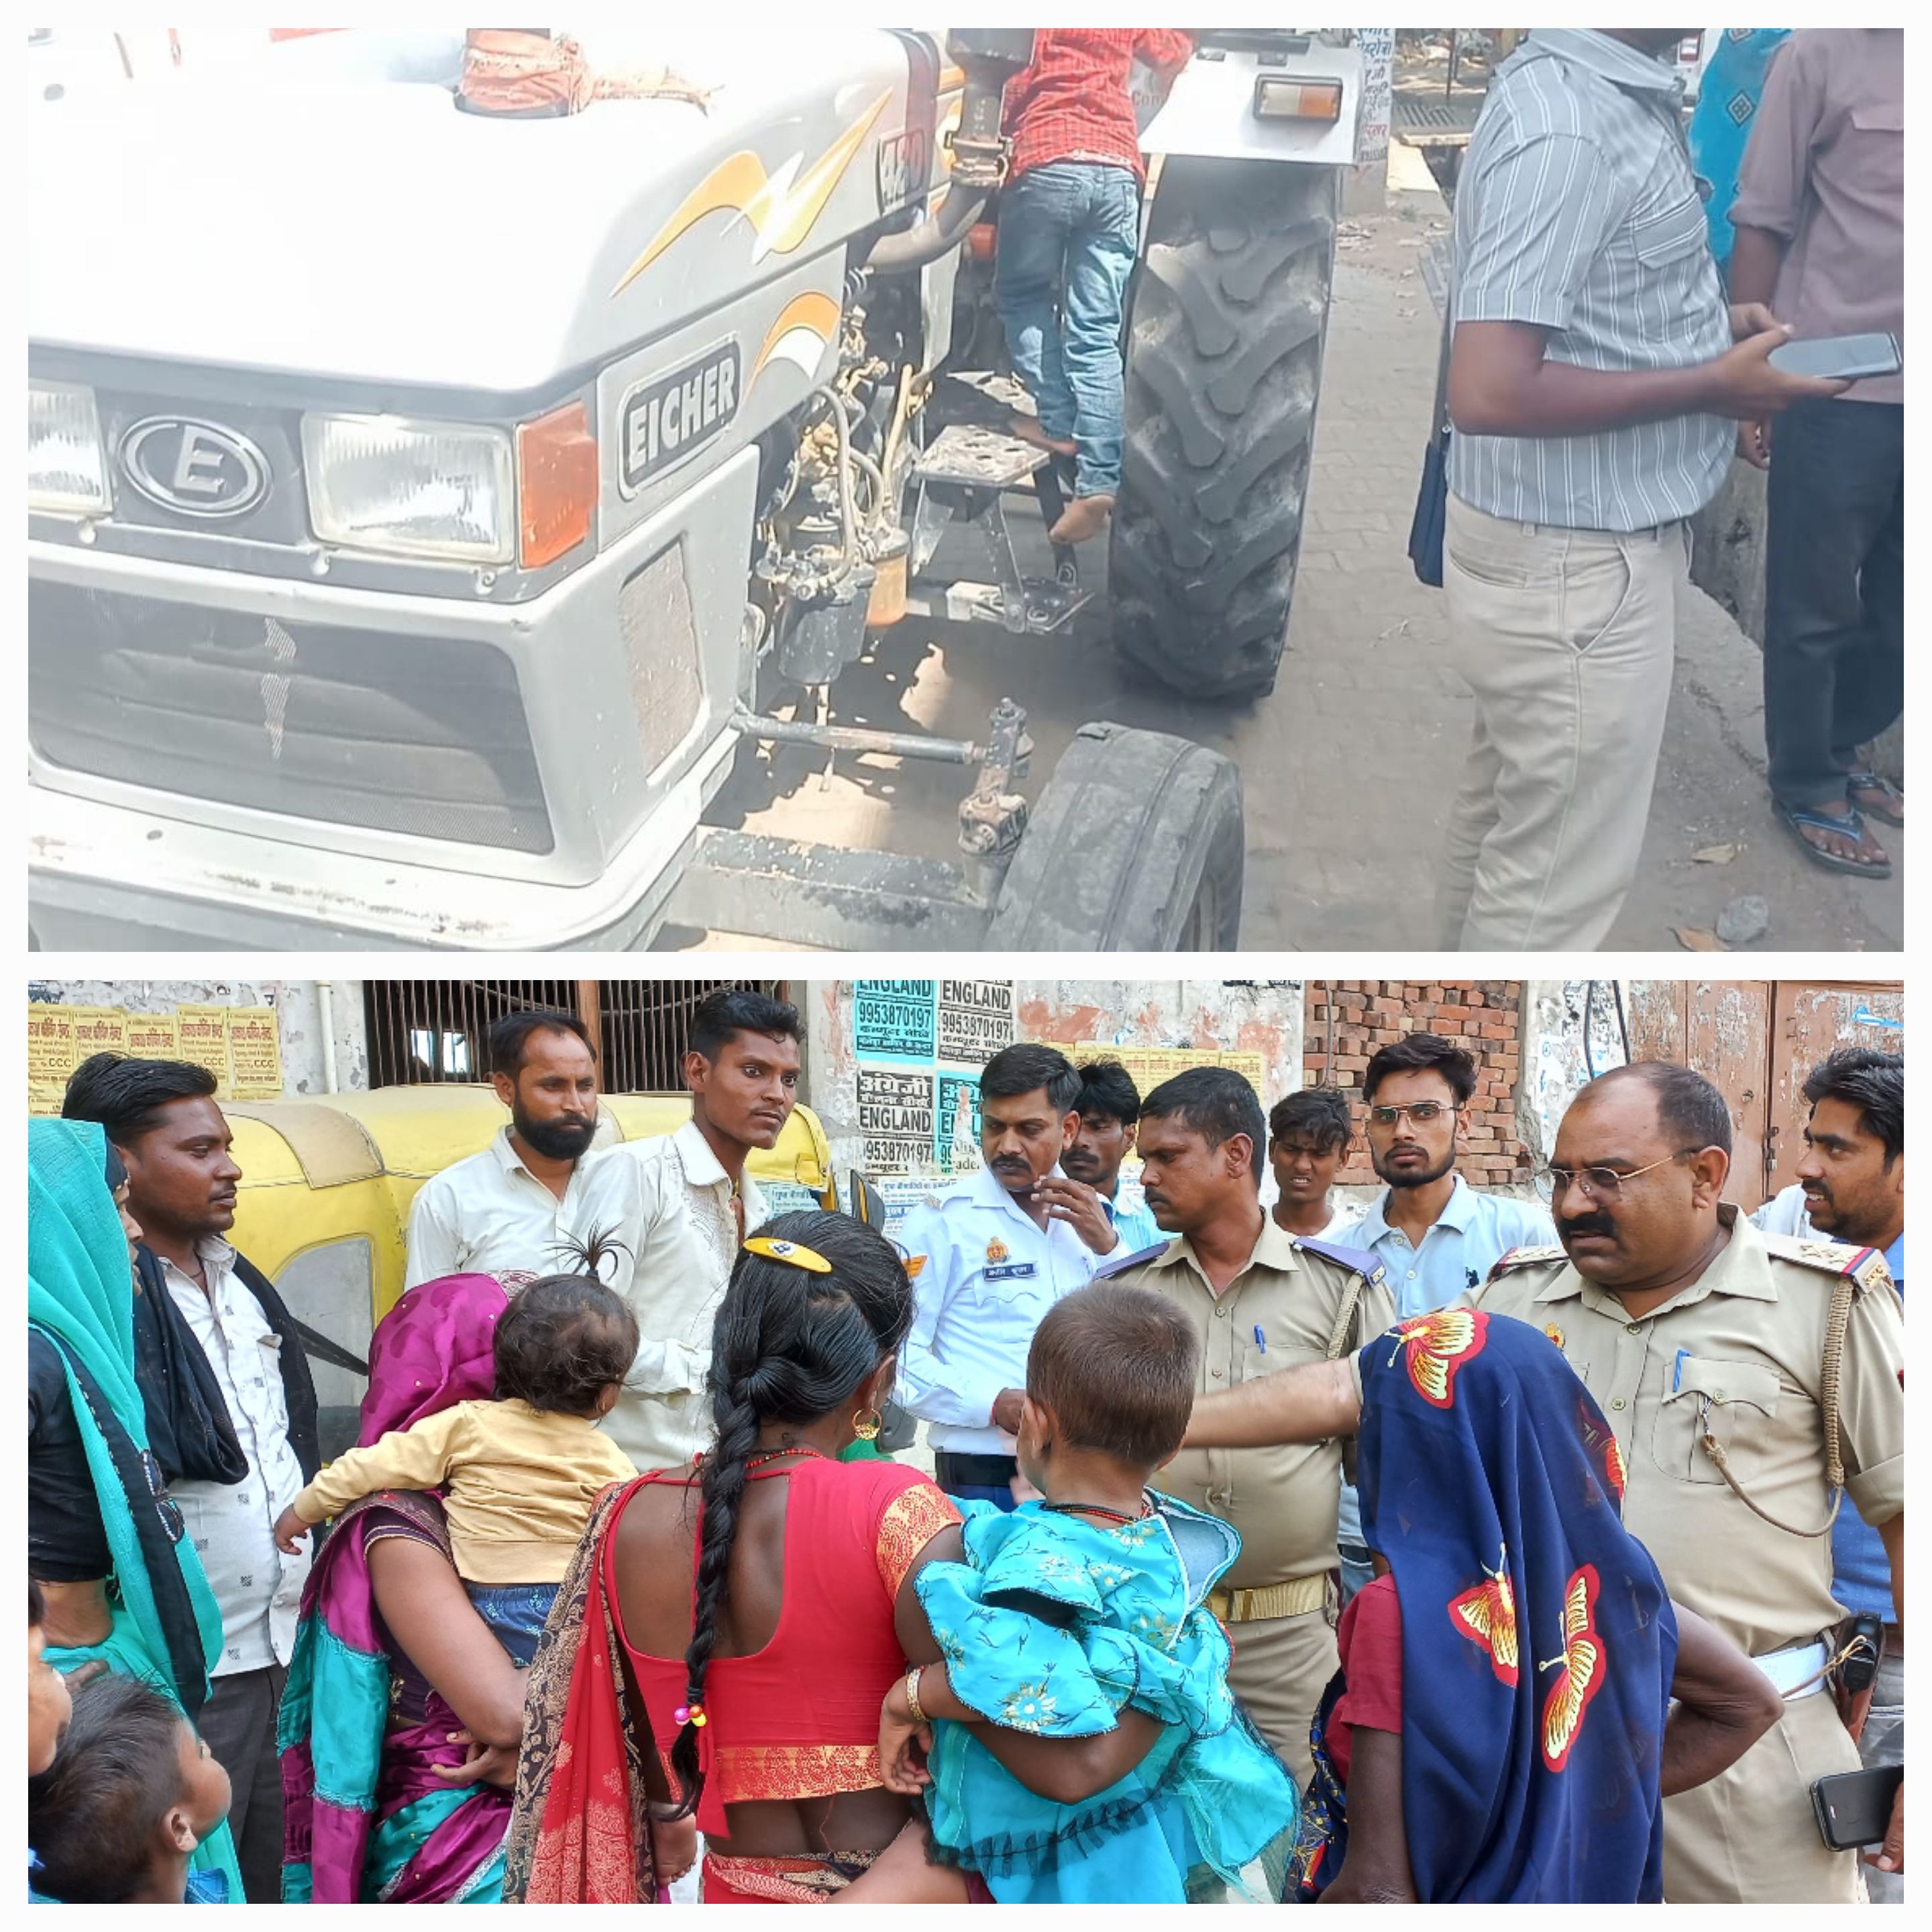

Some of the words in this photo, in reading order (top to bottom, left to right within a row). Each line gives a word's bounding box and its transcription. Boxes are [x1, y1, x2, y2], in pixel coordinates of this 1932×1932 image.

[629, 357, 735, 474] EICHER
[859, 980, 931, 997] ENGLAND
[942, 980, 1011, 1010] ENGLAND
[859, 1001, 931, 1028] 9953870197
[942, 1012, 1010, 1040] 9953870197
[48, 1057, 72, 1067] CCC
[254, 1059, 275, 1069] CCC
[859, 1072, 932, 1097] अंग्रेजी
[859, 1106, 931, 1132] ENGLAND
[863, 1140, 931, 1163] 953870197
